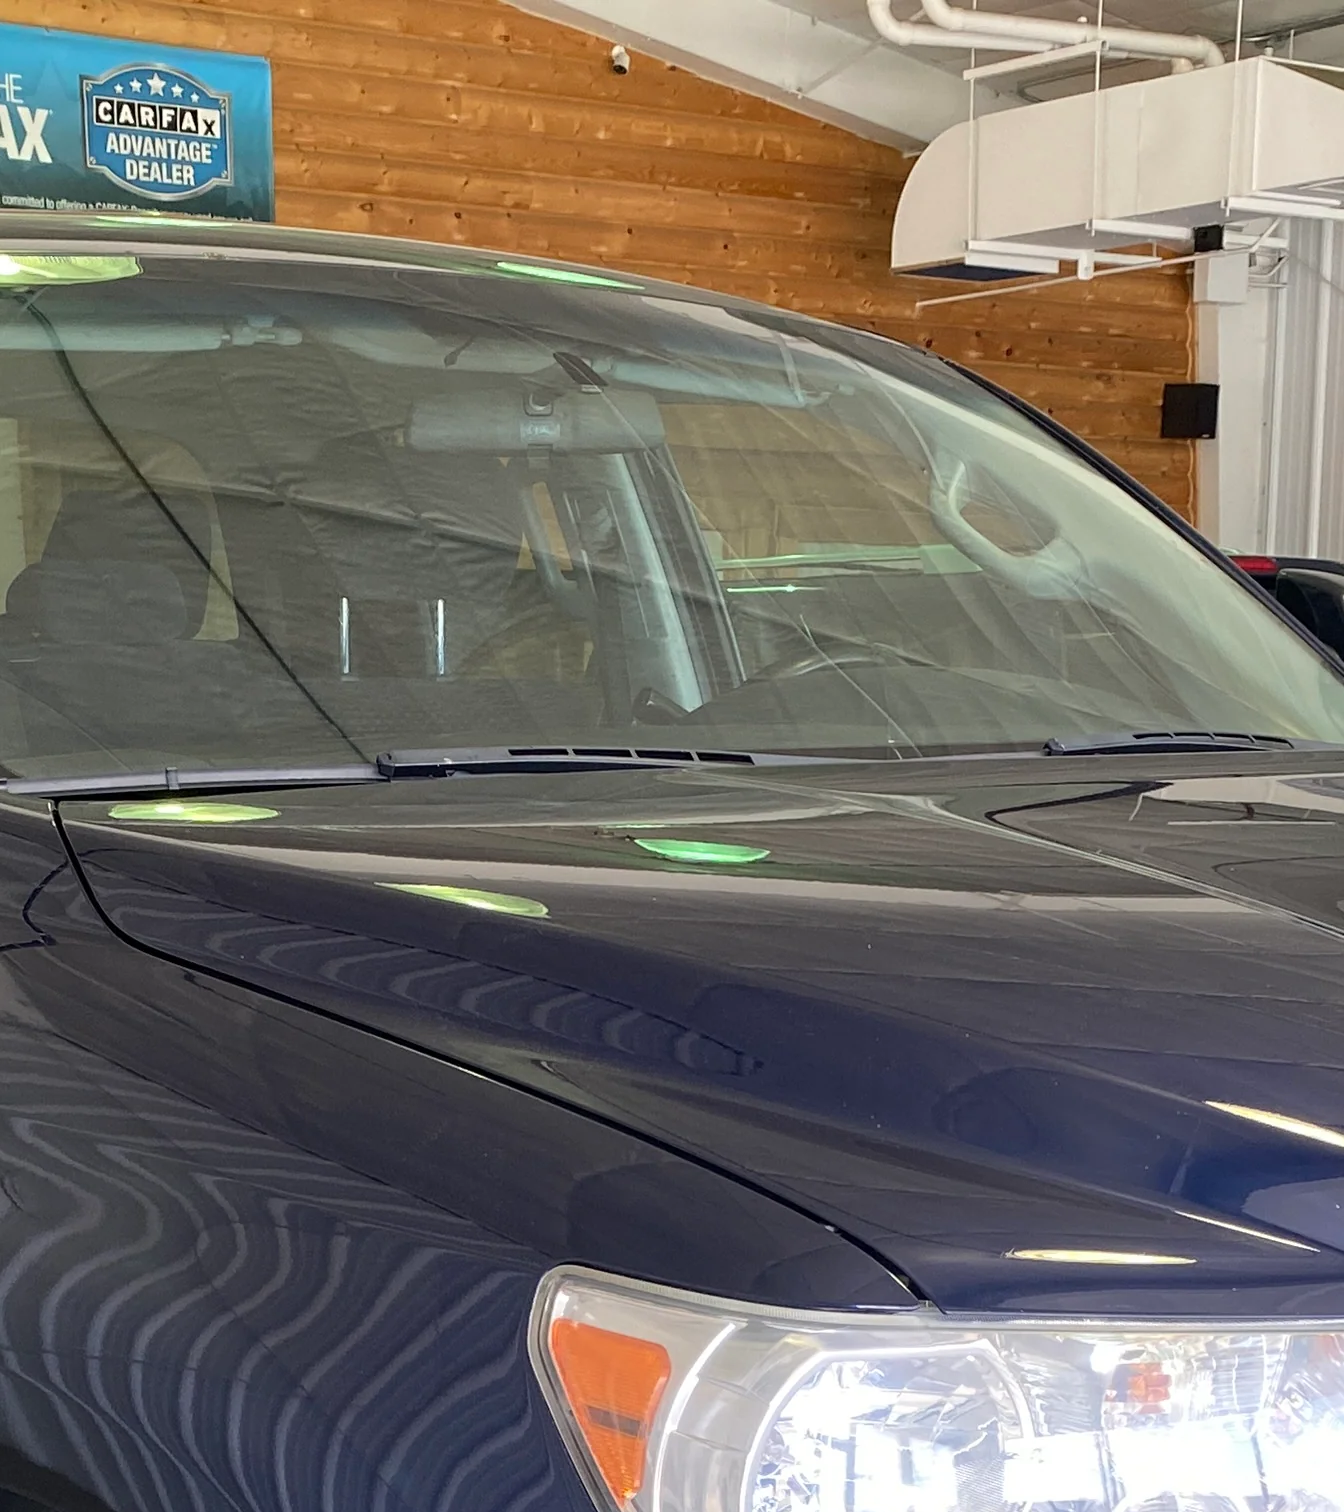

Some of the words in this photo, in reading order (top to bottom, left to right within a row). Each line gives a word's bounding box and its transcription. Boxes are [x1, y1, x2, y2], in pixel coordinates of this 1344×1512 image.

[96, 101, 217, 138] CARFAX
[106, 133, 213, 164] ADVANTAGE
[125, 157, 195, 187] DEALER
[2, 194, 44, 209] committed
[46, 197, 55, 209] to
